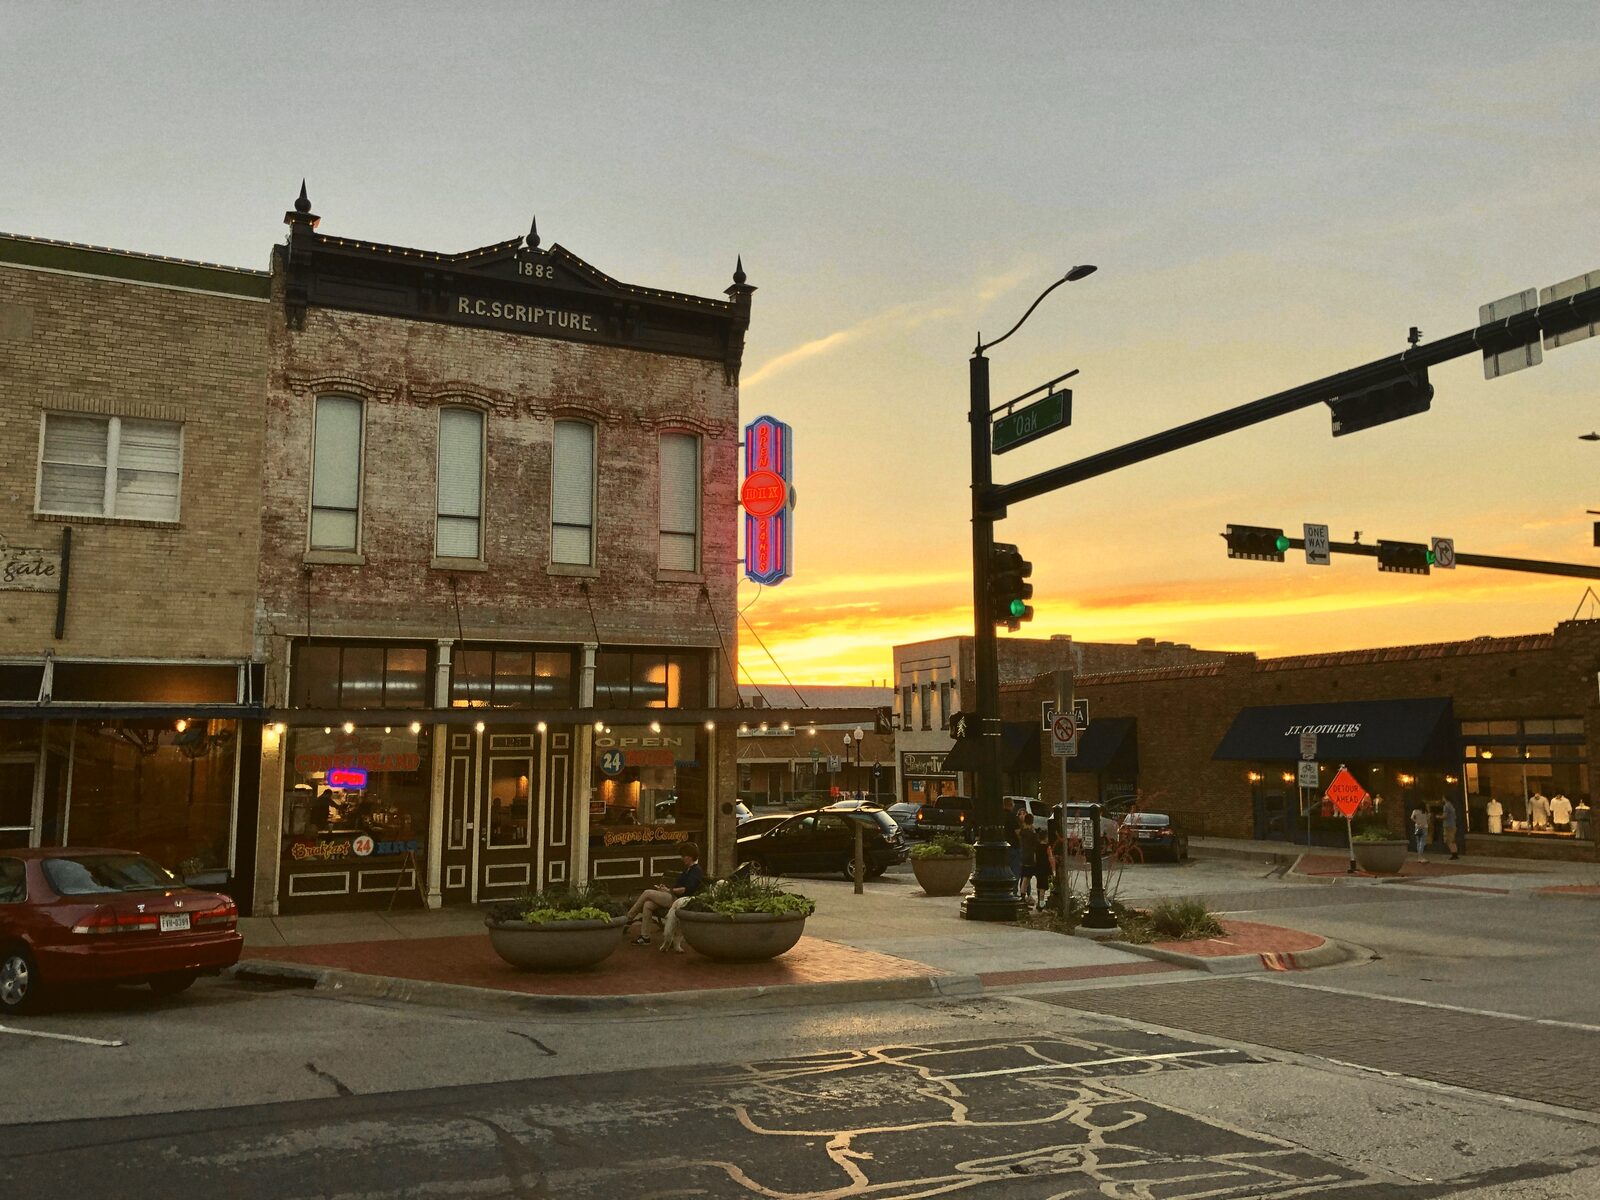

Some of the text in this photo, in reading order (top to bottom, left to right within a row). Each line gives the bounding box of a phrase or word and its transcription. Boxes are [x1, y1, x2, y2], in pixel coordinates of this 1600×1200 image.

[519, 261, 553, 279] 1882
[1016, 410, 1038, 436] Oak
[759, 426, 769, 467] OPEN
[745, 486, 779, 500] DIX
[1308, 527, 1325, 538] ONE
[1308, 538, 1325, 549] WAY
[3, 557, 56, 583] gate
[1284, 723, 1362, 736] J.T. CLOTHIERS
[595, 737, 682, 747] OPEN
[603, 752, 621, 772] 24
[1333, 784, 1360, 793] DETOUR
[1336, 795, 1359, 803] AHEAD
[292, 841, 350, 860] Breakfast
[356, 840, 371, 853] 24
